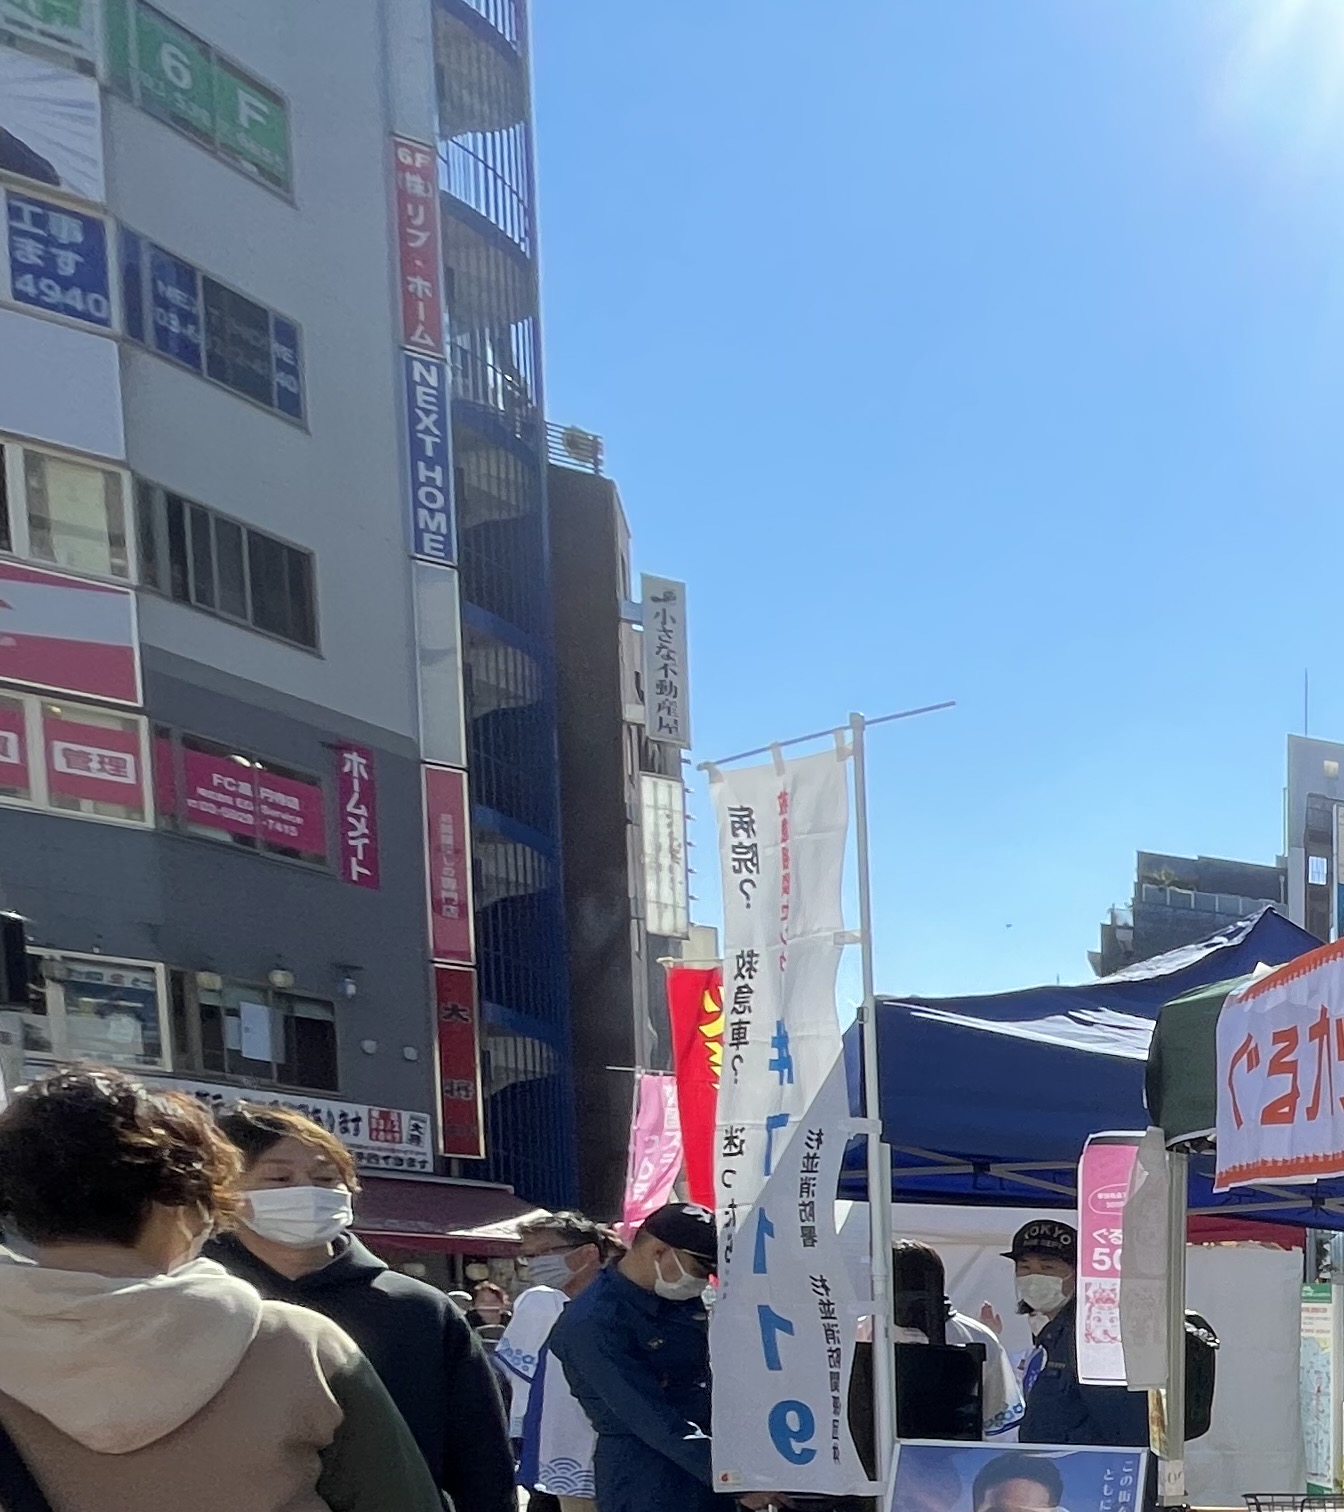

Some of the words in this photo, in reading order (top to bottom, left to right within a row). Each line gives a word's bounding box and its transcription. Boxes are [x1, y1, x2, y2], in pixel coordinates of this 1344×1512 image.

[412, 359, 442, 457] NEXT
[417, 460, 449, 558] HOME
[651, 607, 680, 737] 小さな不動産屋
[1024, 1222, 1073, 1246] TOKYO
